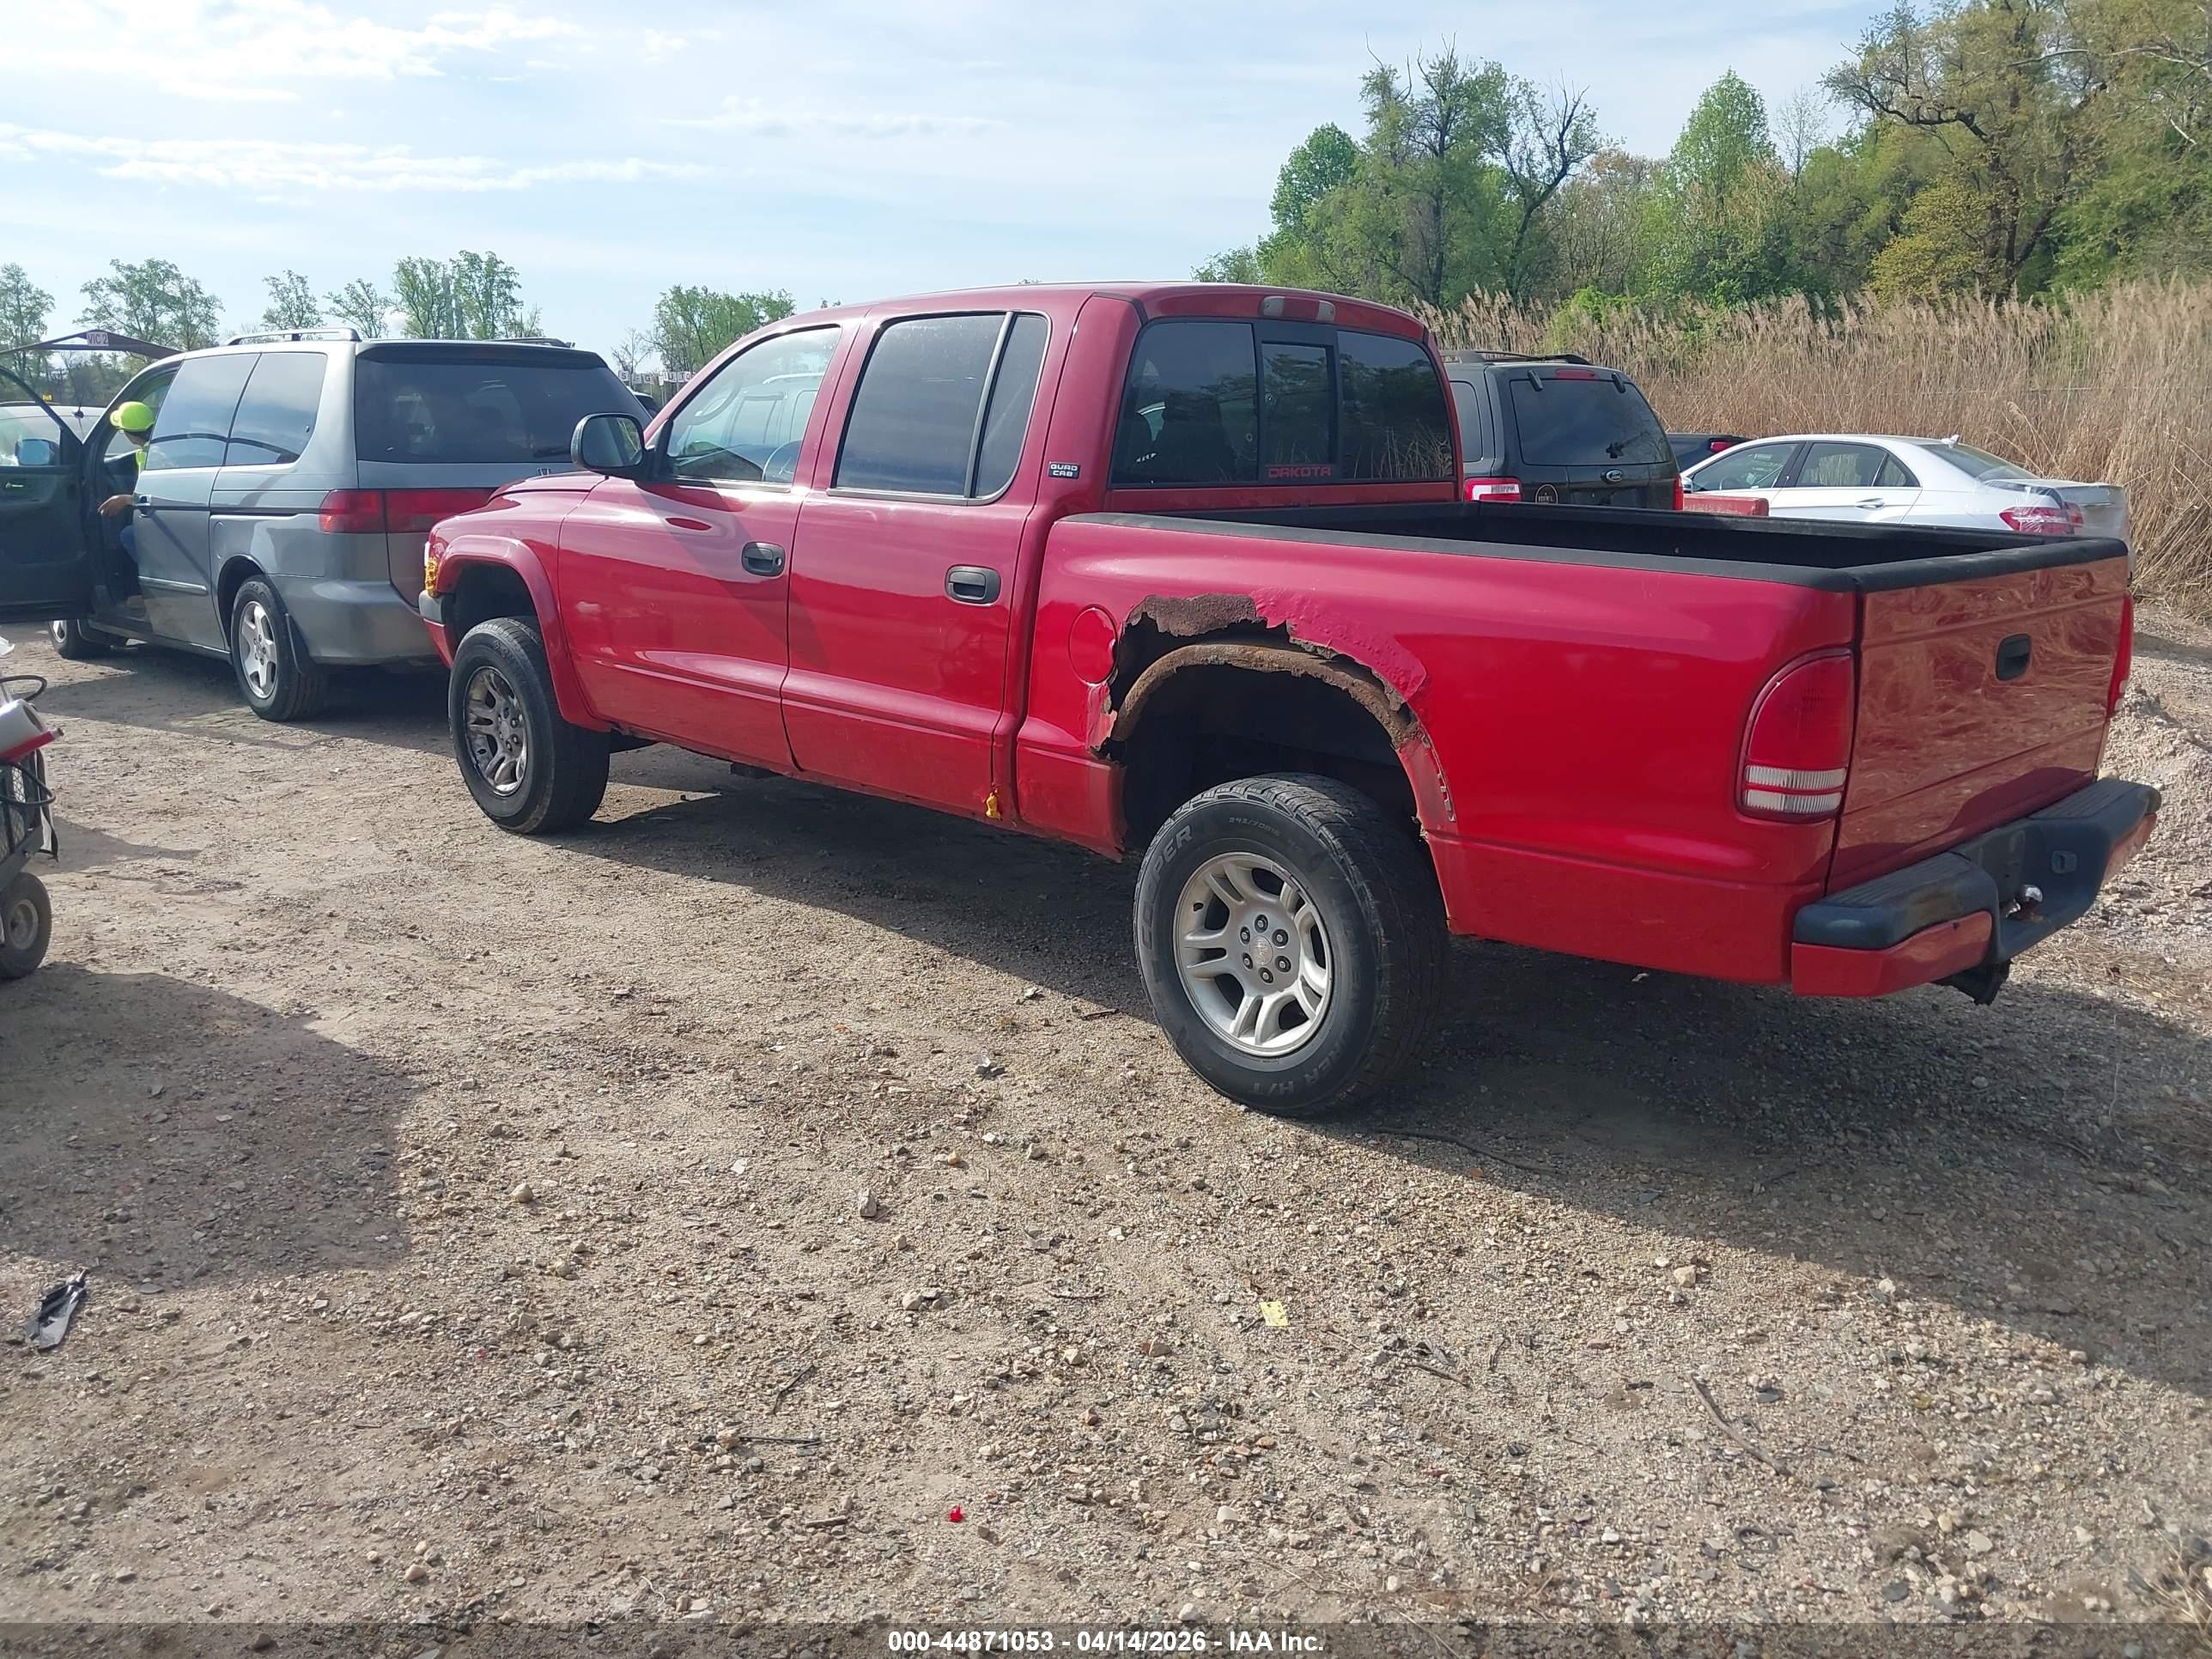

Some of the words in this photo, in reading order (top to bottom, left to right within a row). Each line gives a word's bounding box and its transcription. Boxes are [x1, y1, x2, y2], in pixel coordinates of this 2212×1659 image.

[88, 333, 101, 344] VIC
[102, 333, 108, 344] 2
[1267, 466, 1332, 478] DAKOTA
